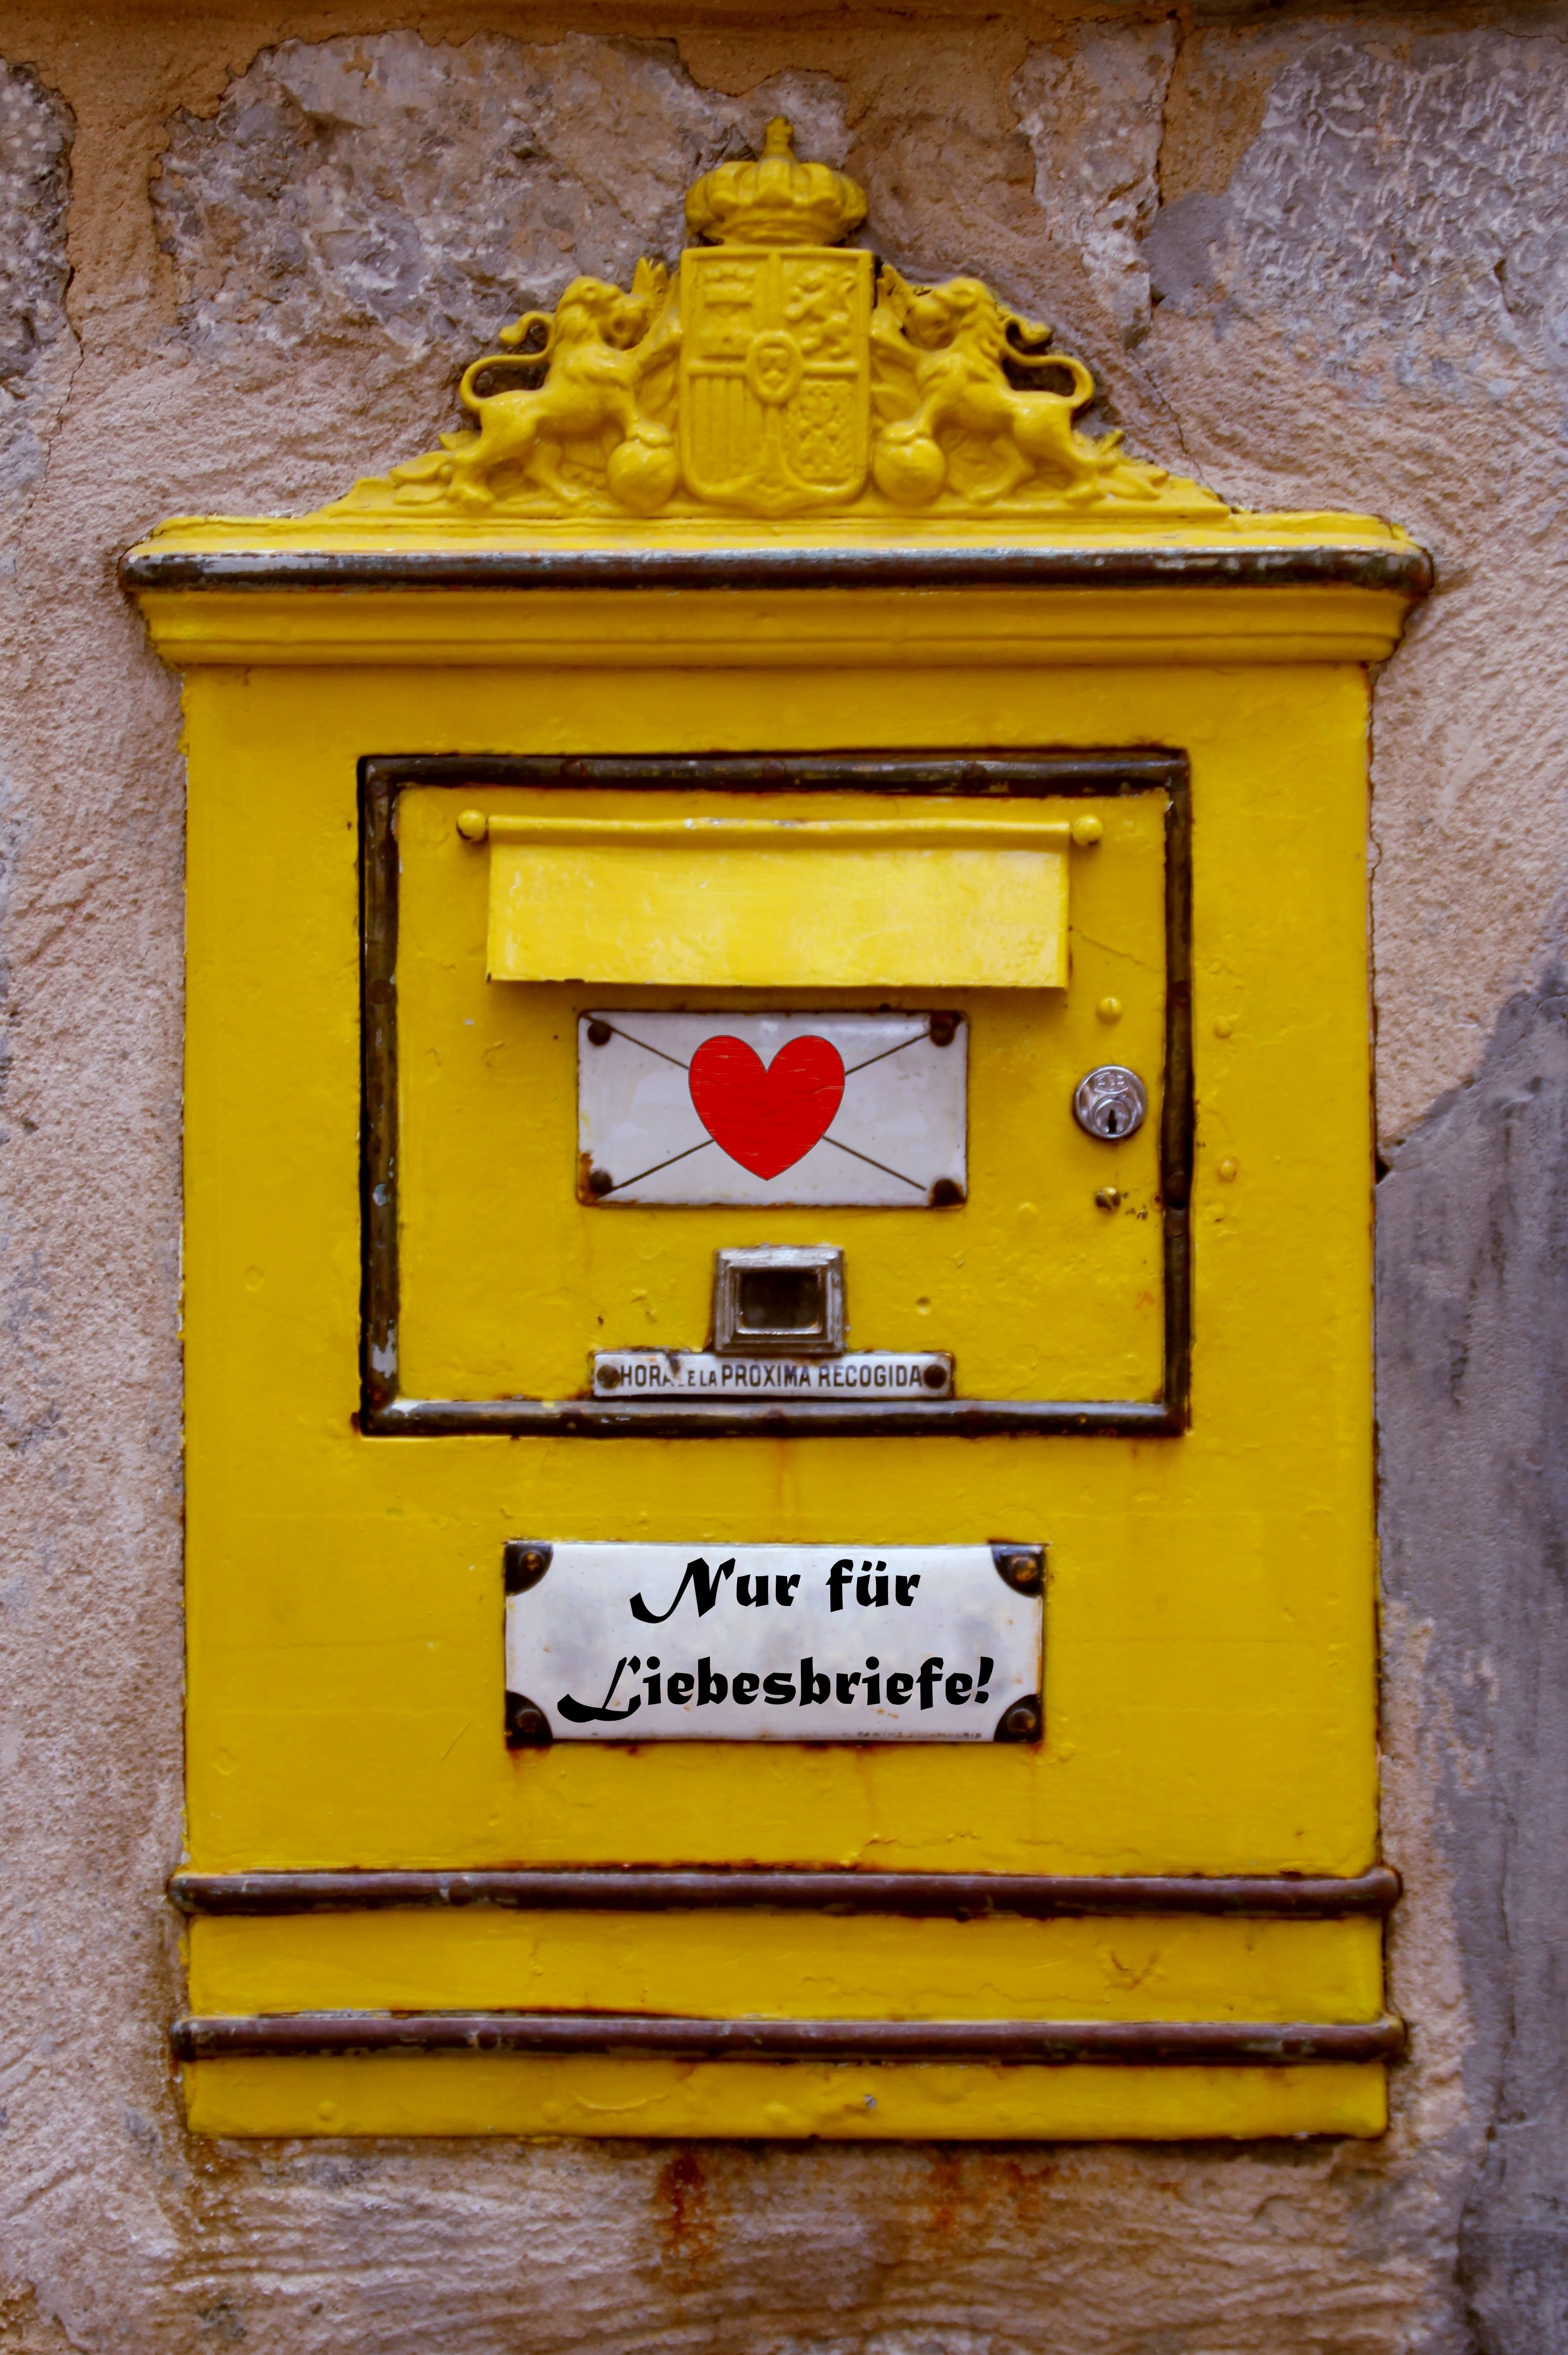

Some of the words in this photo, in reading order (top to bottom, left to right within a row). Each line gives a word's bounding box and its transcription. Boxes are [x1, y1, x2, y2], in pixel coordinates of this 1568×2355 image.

[678, 1370, 696, 1387] E
[700, 1370, 717, 1387] LA
[721, 1364, 811, 1387] PROXIMA
[818, 1365, 922, 1387] RECOGIDA
[629, 1557, 800, 1623] Nur
[826, 1559, 921, 1613] für
[557, 1656, 994, 1723] Liebesbriefe!
